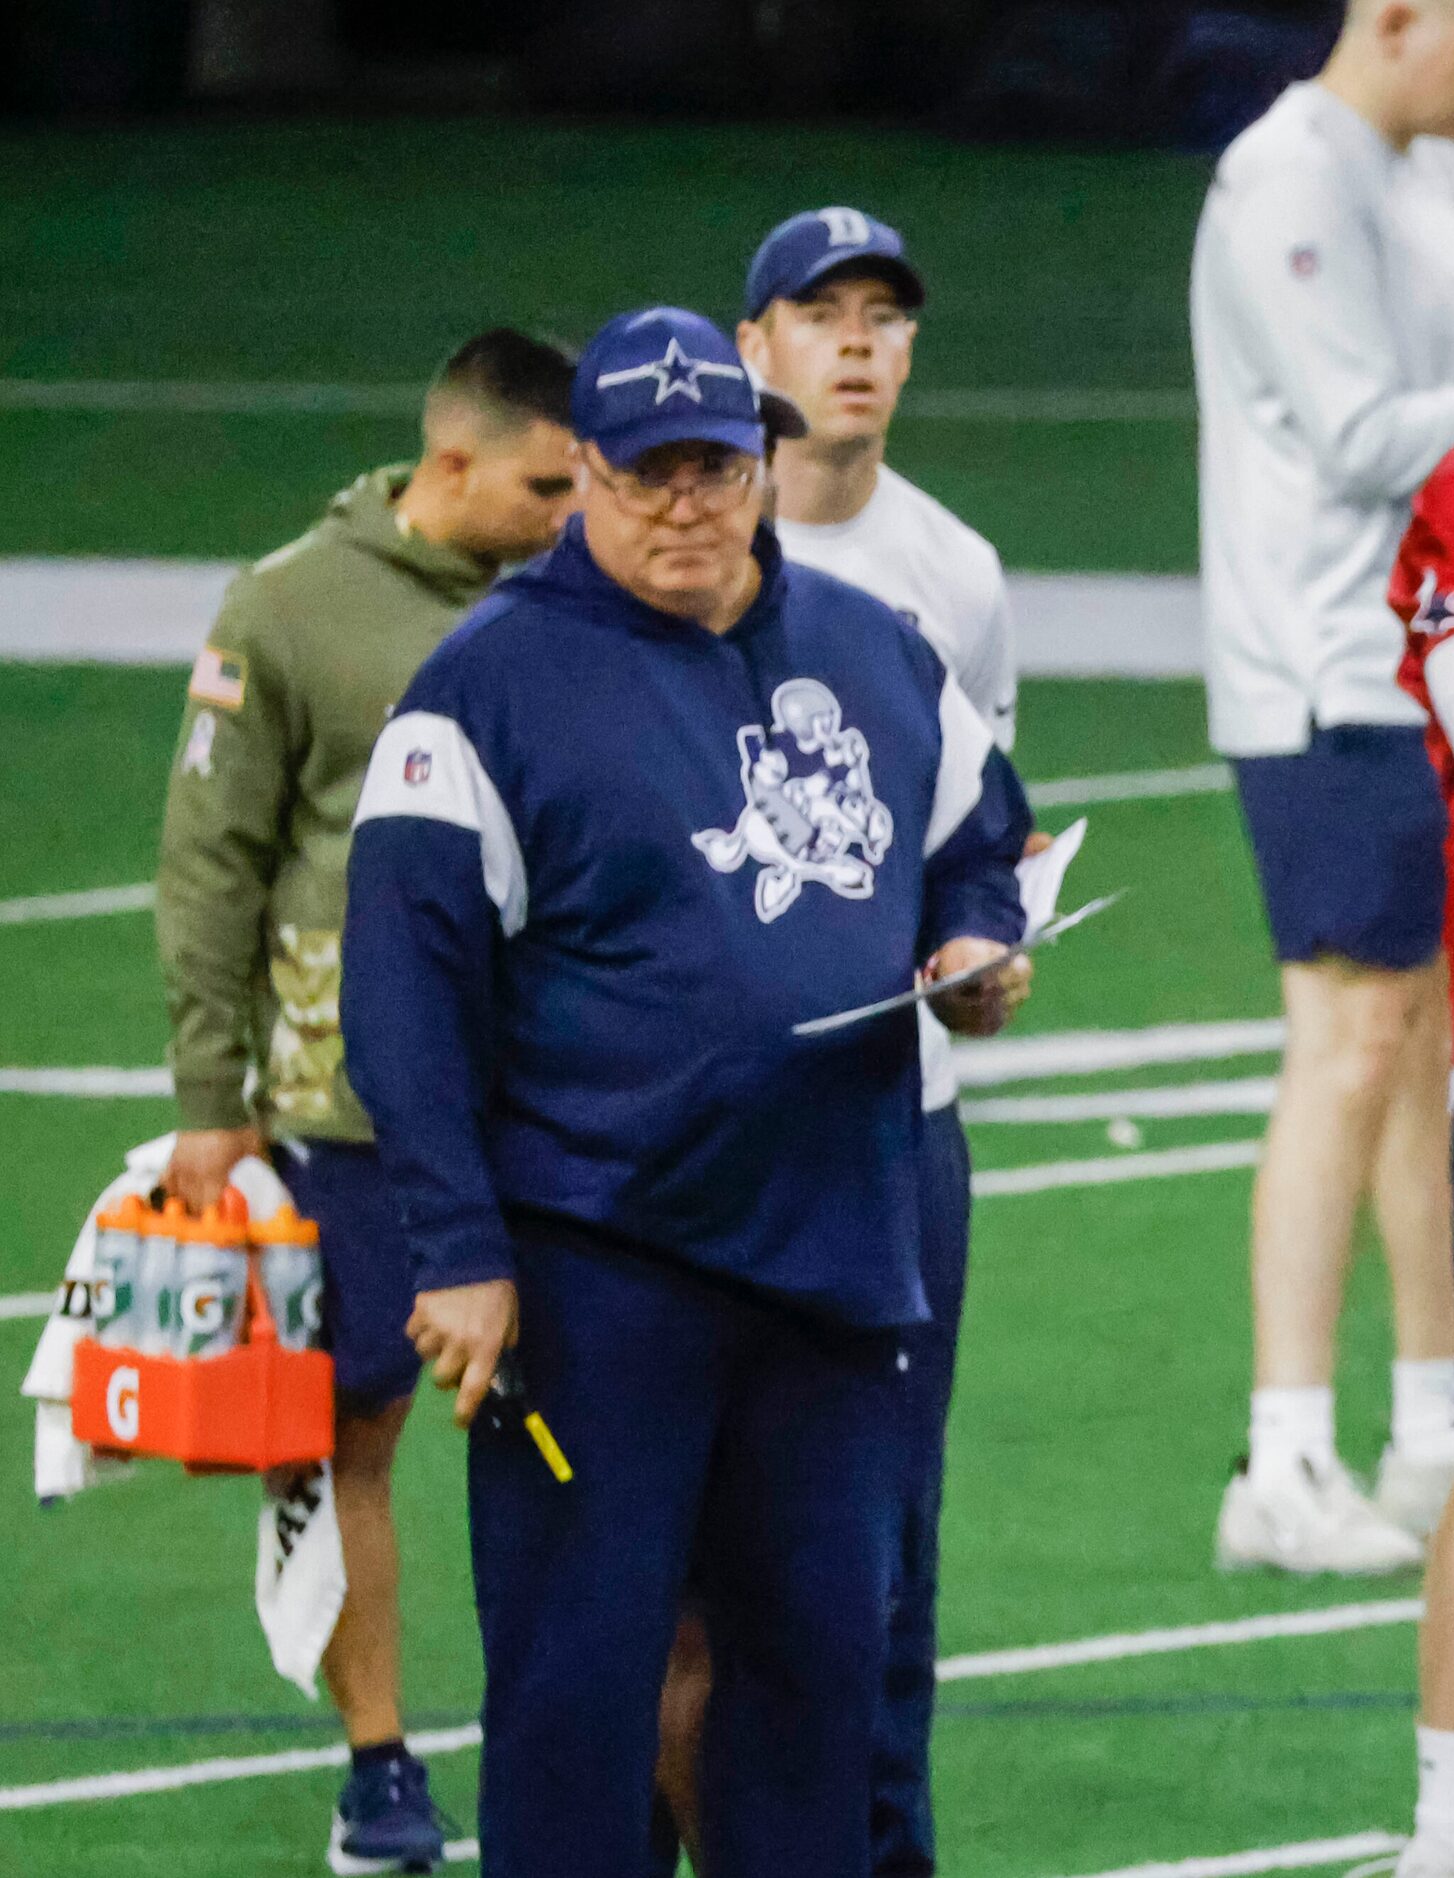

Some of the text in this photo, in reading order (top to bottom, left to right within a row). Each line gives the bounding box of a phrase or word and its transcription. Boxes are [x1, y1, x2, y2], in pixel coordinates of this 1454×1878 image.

[817, 206, 869, 248] D
[180, 1278, 224, 1334] G
[105, 1364, 140, 1442] G
